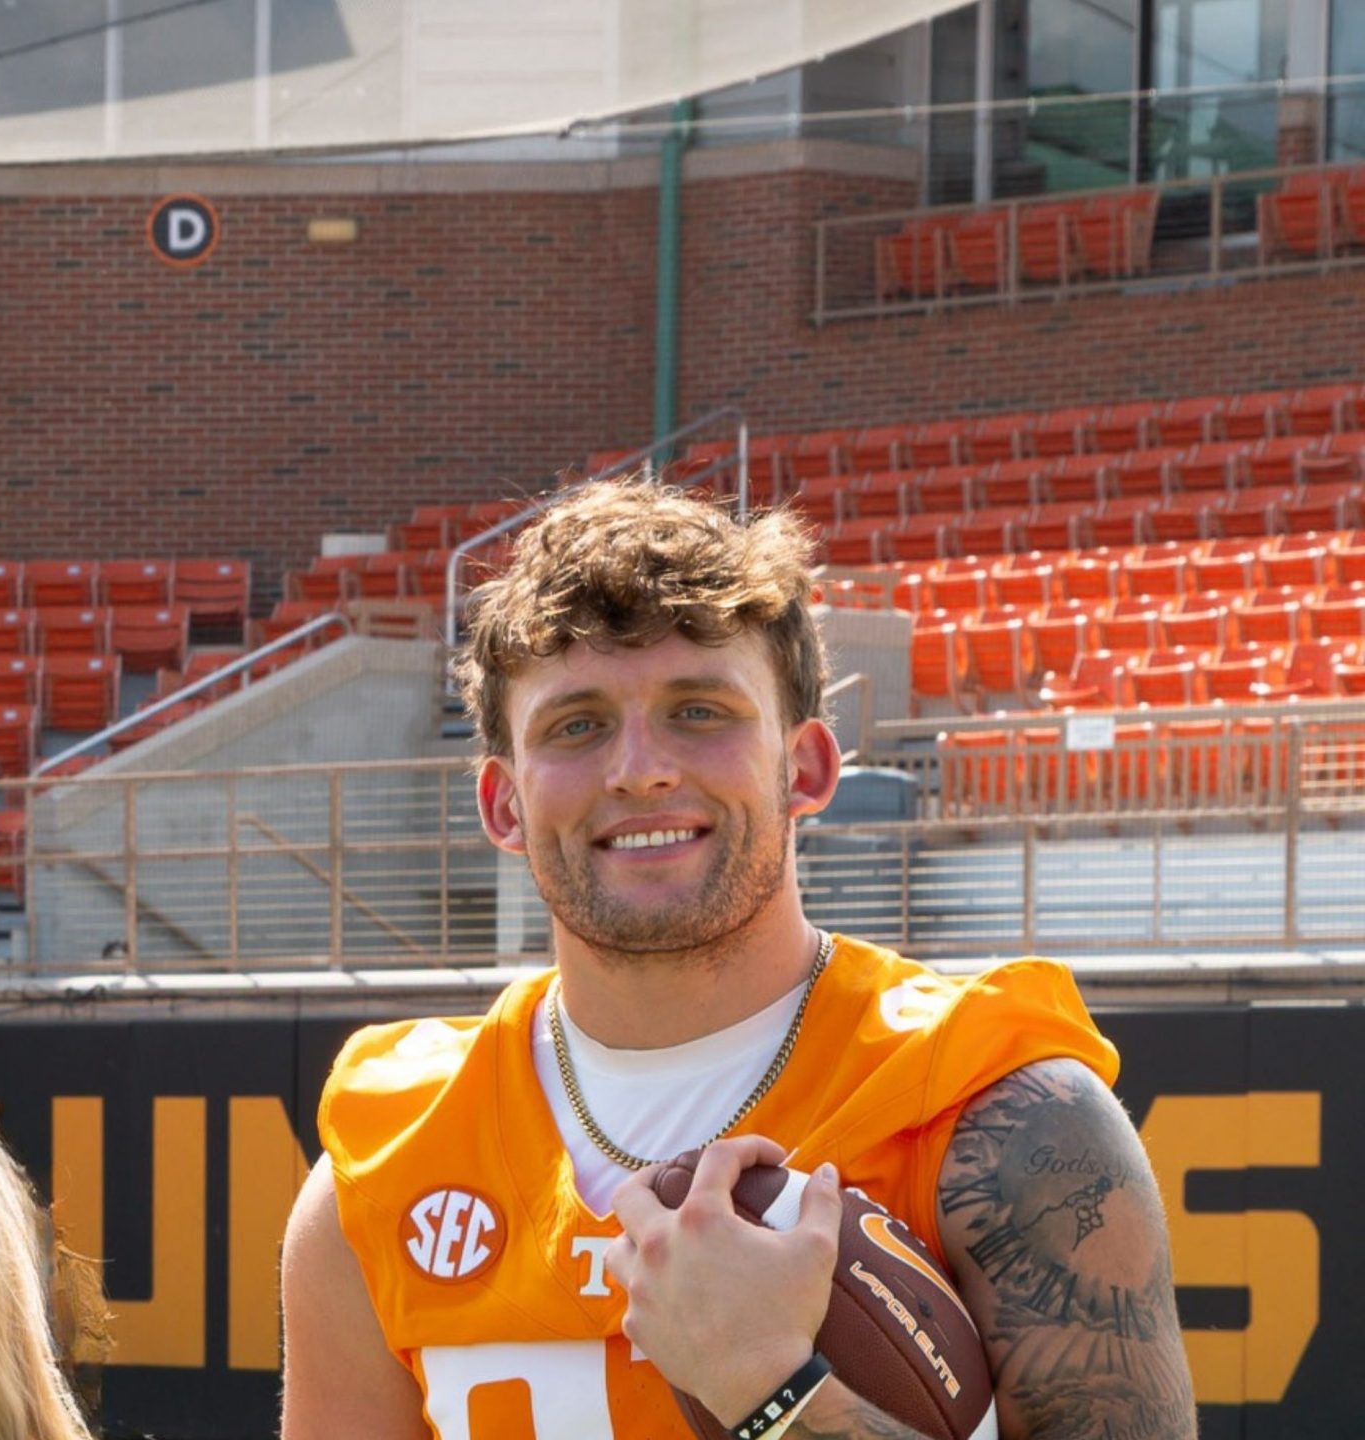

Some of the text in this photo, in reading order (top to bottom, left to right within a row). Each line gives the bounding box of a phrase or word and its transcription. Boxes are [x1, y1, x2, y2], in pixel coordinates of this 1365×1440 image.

[167, 208, 206, 252] D
[406, 1189, 497, 1278] SEC
[571, 1236, 623, 1296] T
[849, 1260, 961, 1399] VAPOR ELITE
